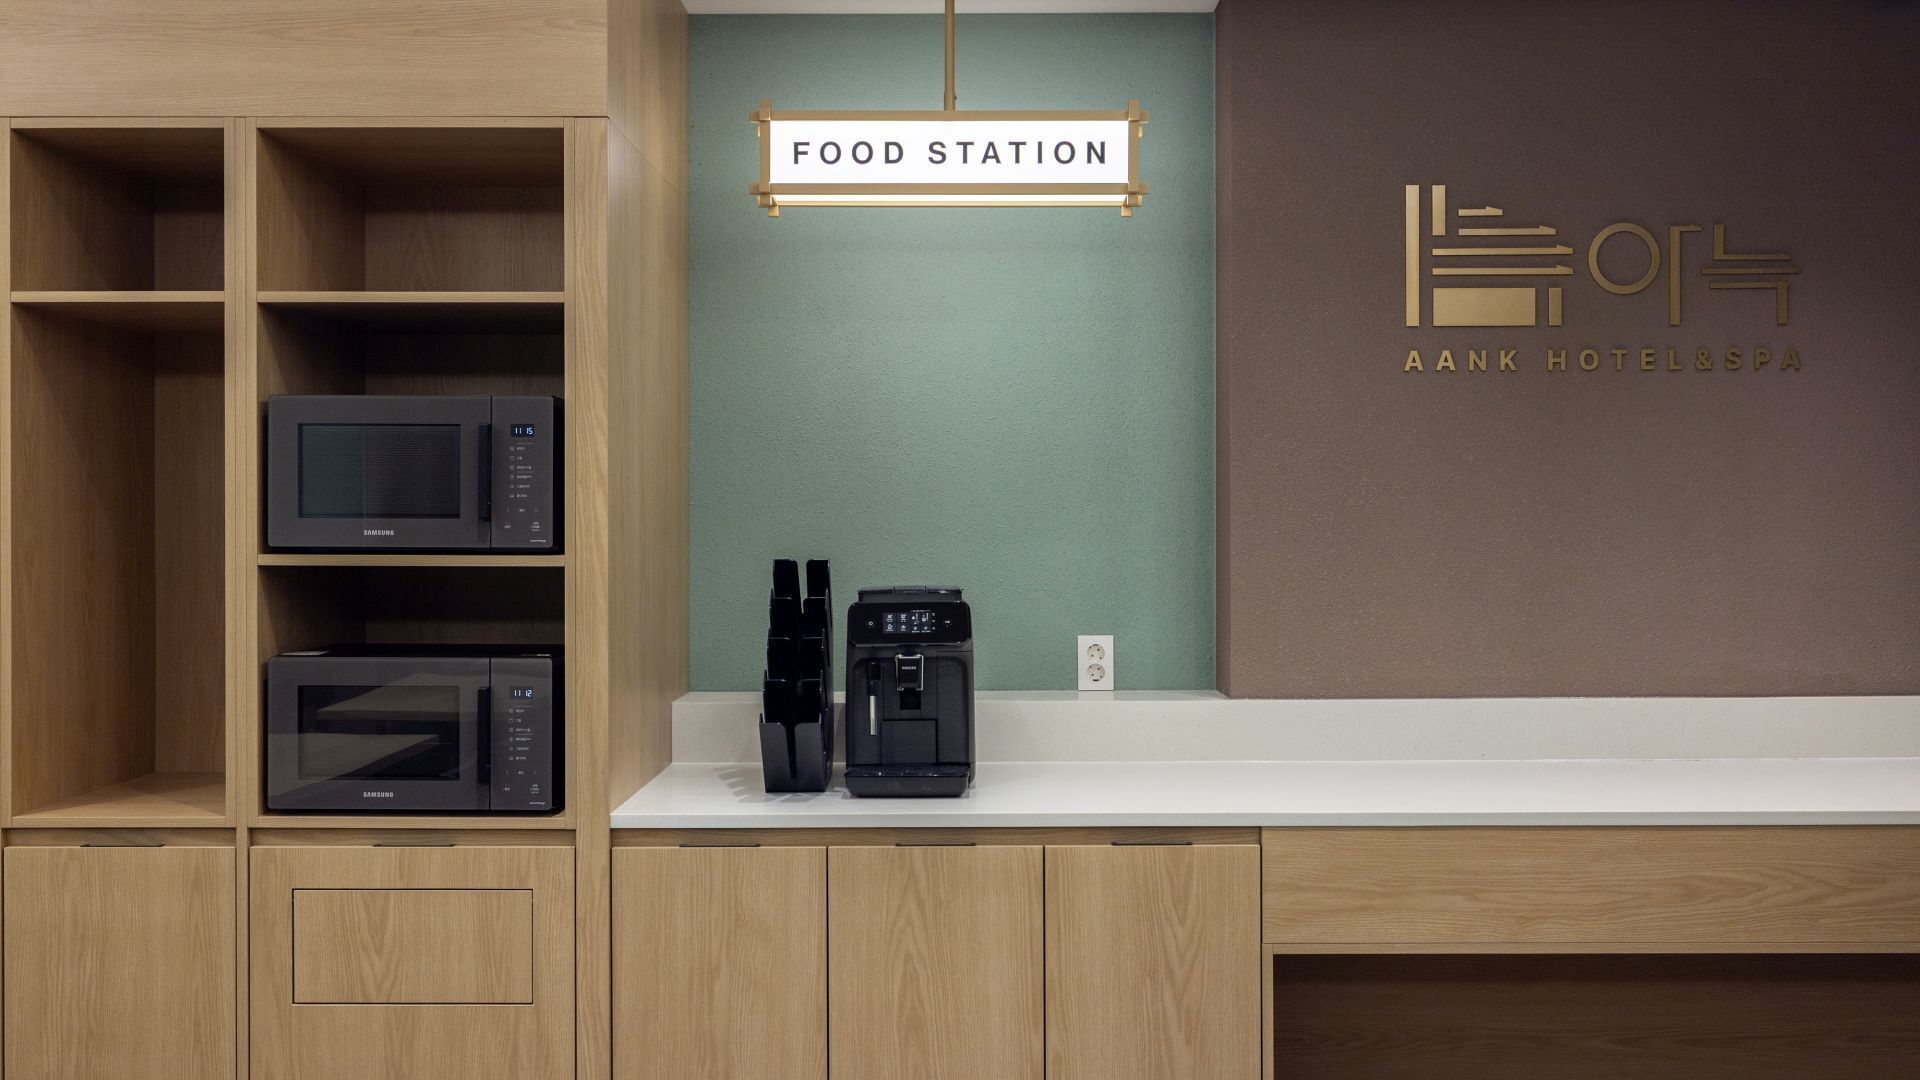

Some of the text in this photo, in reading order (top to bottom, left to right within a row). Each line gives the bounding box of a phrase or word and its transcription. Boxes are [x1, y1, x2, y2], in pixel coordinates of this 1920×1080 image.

[793, 141, 1106, 165] FOOD STATION
[1403, 349, 1802, 372] AANK HOTEL&SPA
